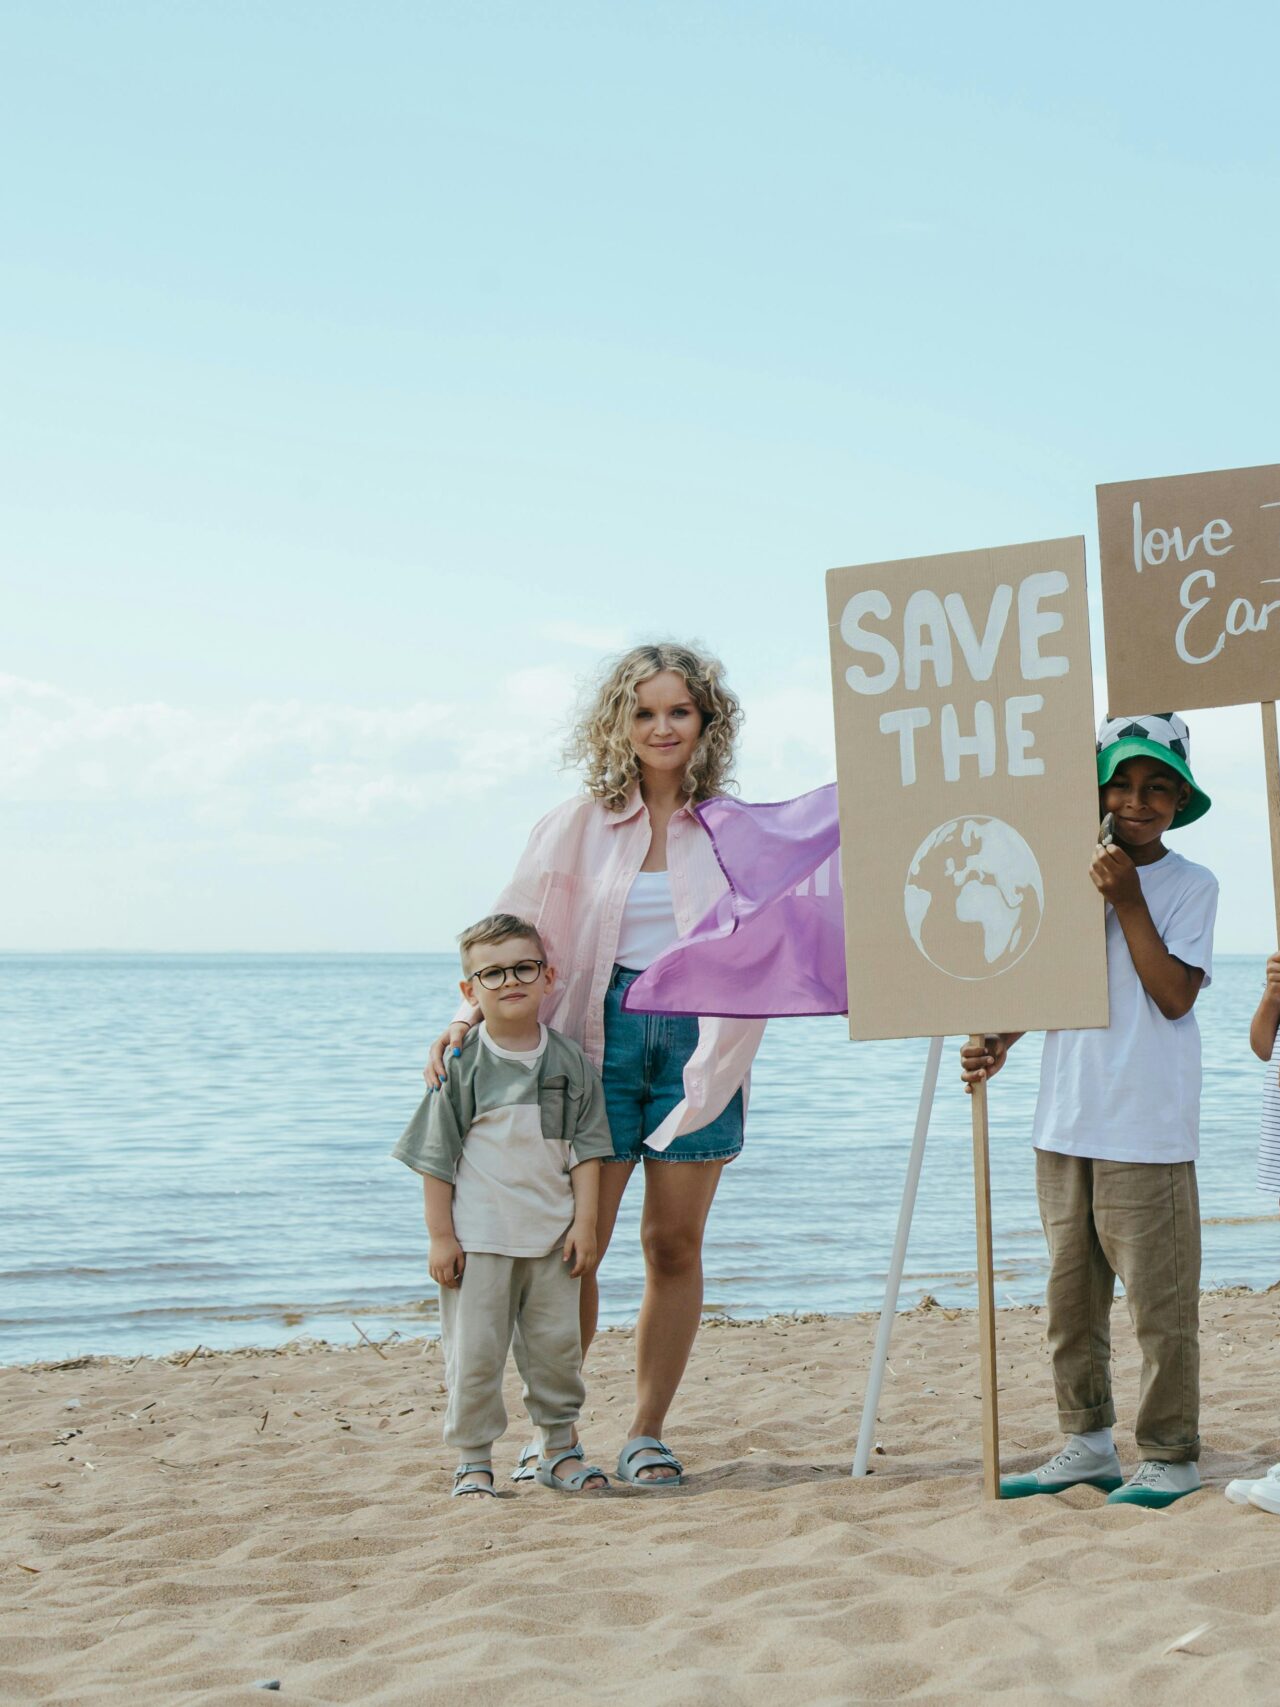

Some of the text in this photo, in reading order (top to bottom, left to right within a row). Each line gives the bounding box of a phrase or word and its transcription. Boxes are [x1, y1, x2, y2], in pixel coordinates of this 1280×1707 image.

[1133, 501, 1235, 573] love
[841, 571, 1069, 695] SAVE
[880, 695, 1045, 786] THE
